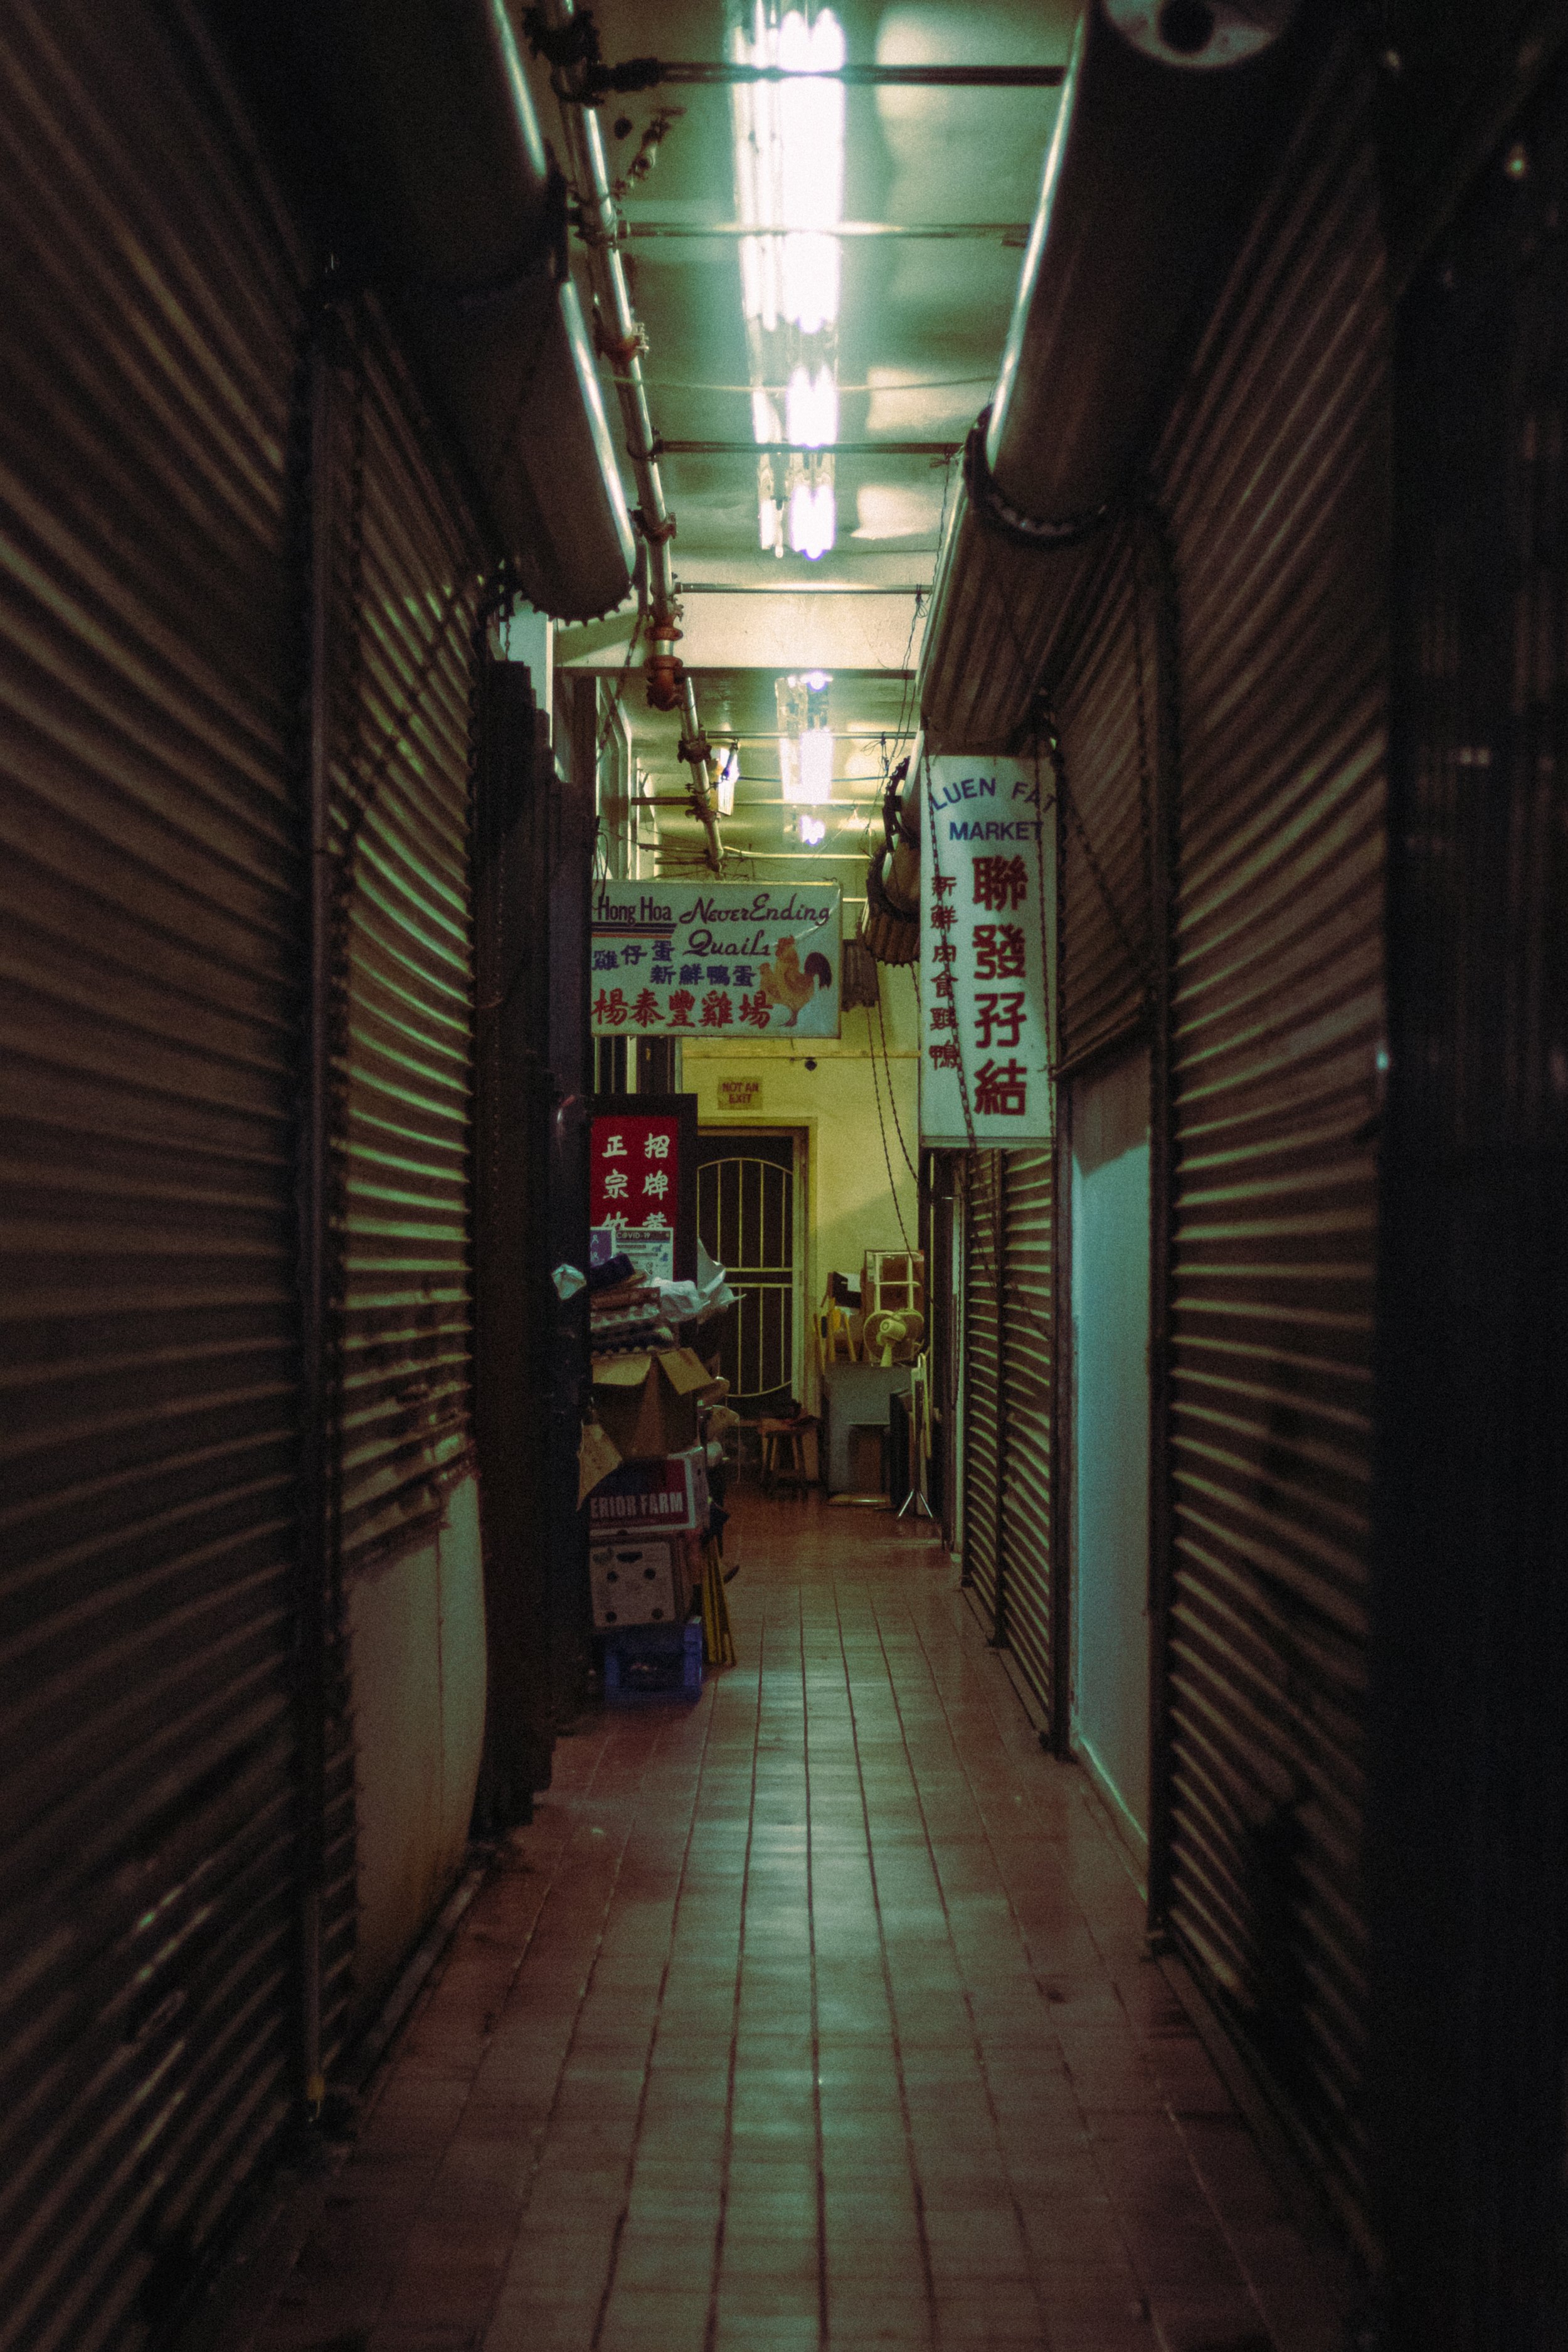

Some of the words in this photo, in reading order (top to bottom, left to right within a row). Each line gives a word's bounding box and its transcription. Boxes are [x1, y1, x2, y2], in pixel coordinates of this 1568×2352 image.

[930, 777, 996, 810] LUEN
[1012, 781, 1057, 813] FAT
[950, 821, 1043, 840] MARKET
[598, 896, 636, 924] Hong
[640, 896, 672, 922] Hoa
[650, 964, 758, 987] 新鮮鴨蛋
[722, 1082, 742, 1092] NOT
[745, 1083, 759, 1092] AN
[729, 1093, 752, 1104] EXIT
[640, 1491, 684, 1515] FARM
